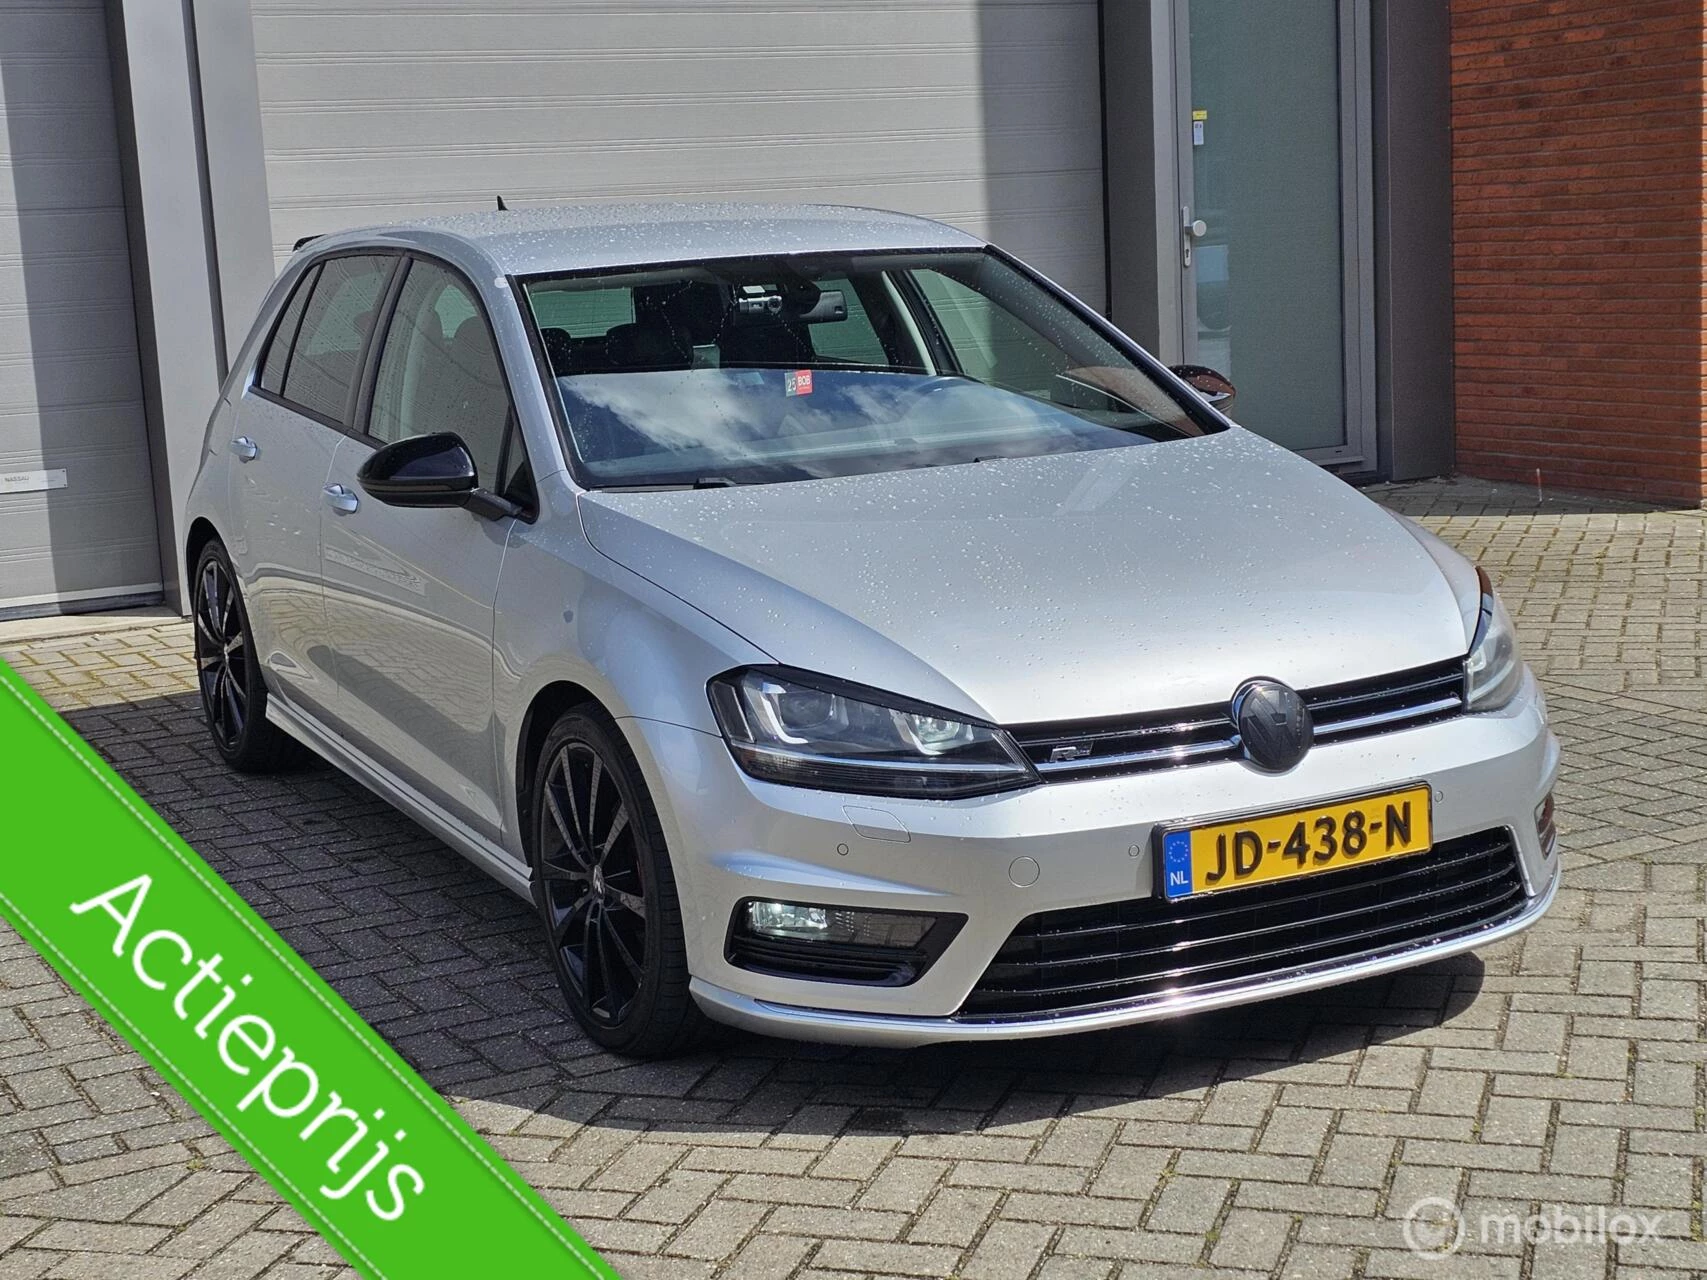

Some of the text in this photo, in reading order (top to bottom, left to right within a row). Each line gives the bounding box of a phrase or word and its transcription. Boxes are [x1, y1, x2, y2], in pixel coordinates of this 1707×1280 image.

[798, 375, 811, 386] BOB
[1169, 800, 1411, 887] NL JD-438-N
